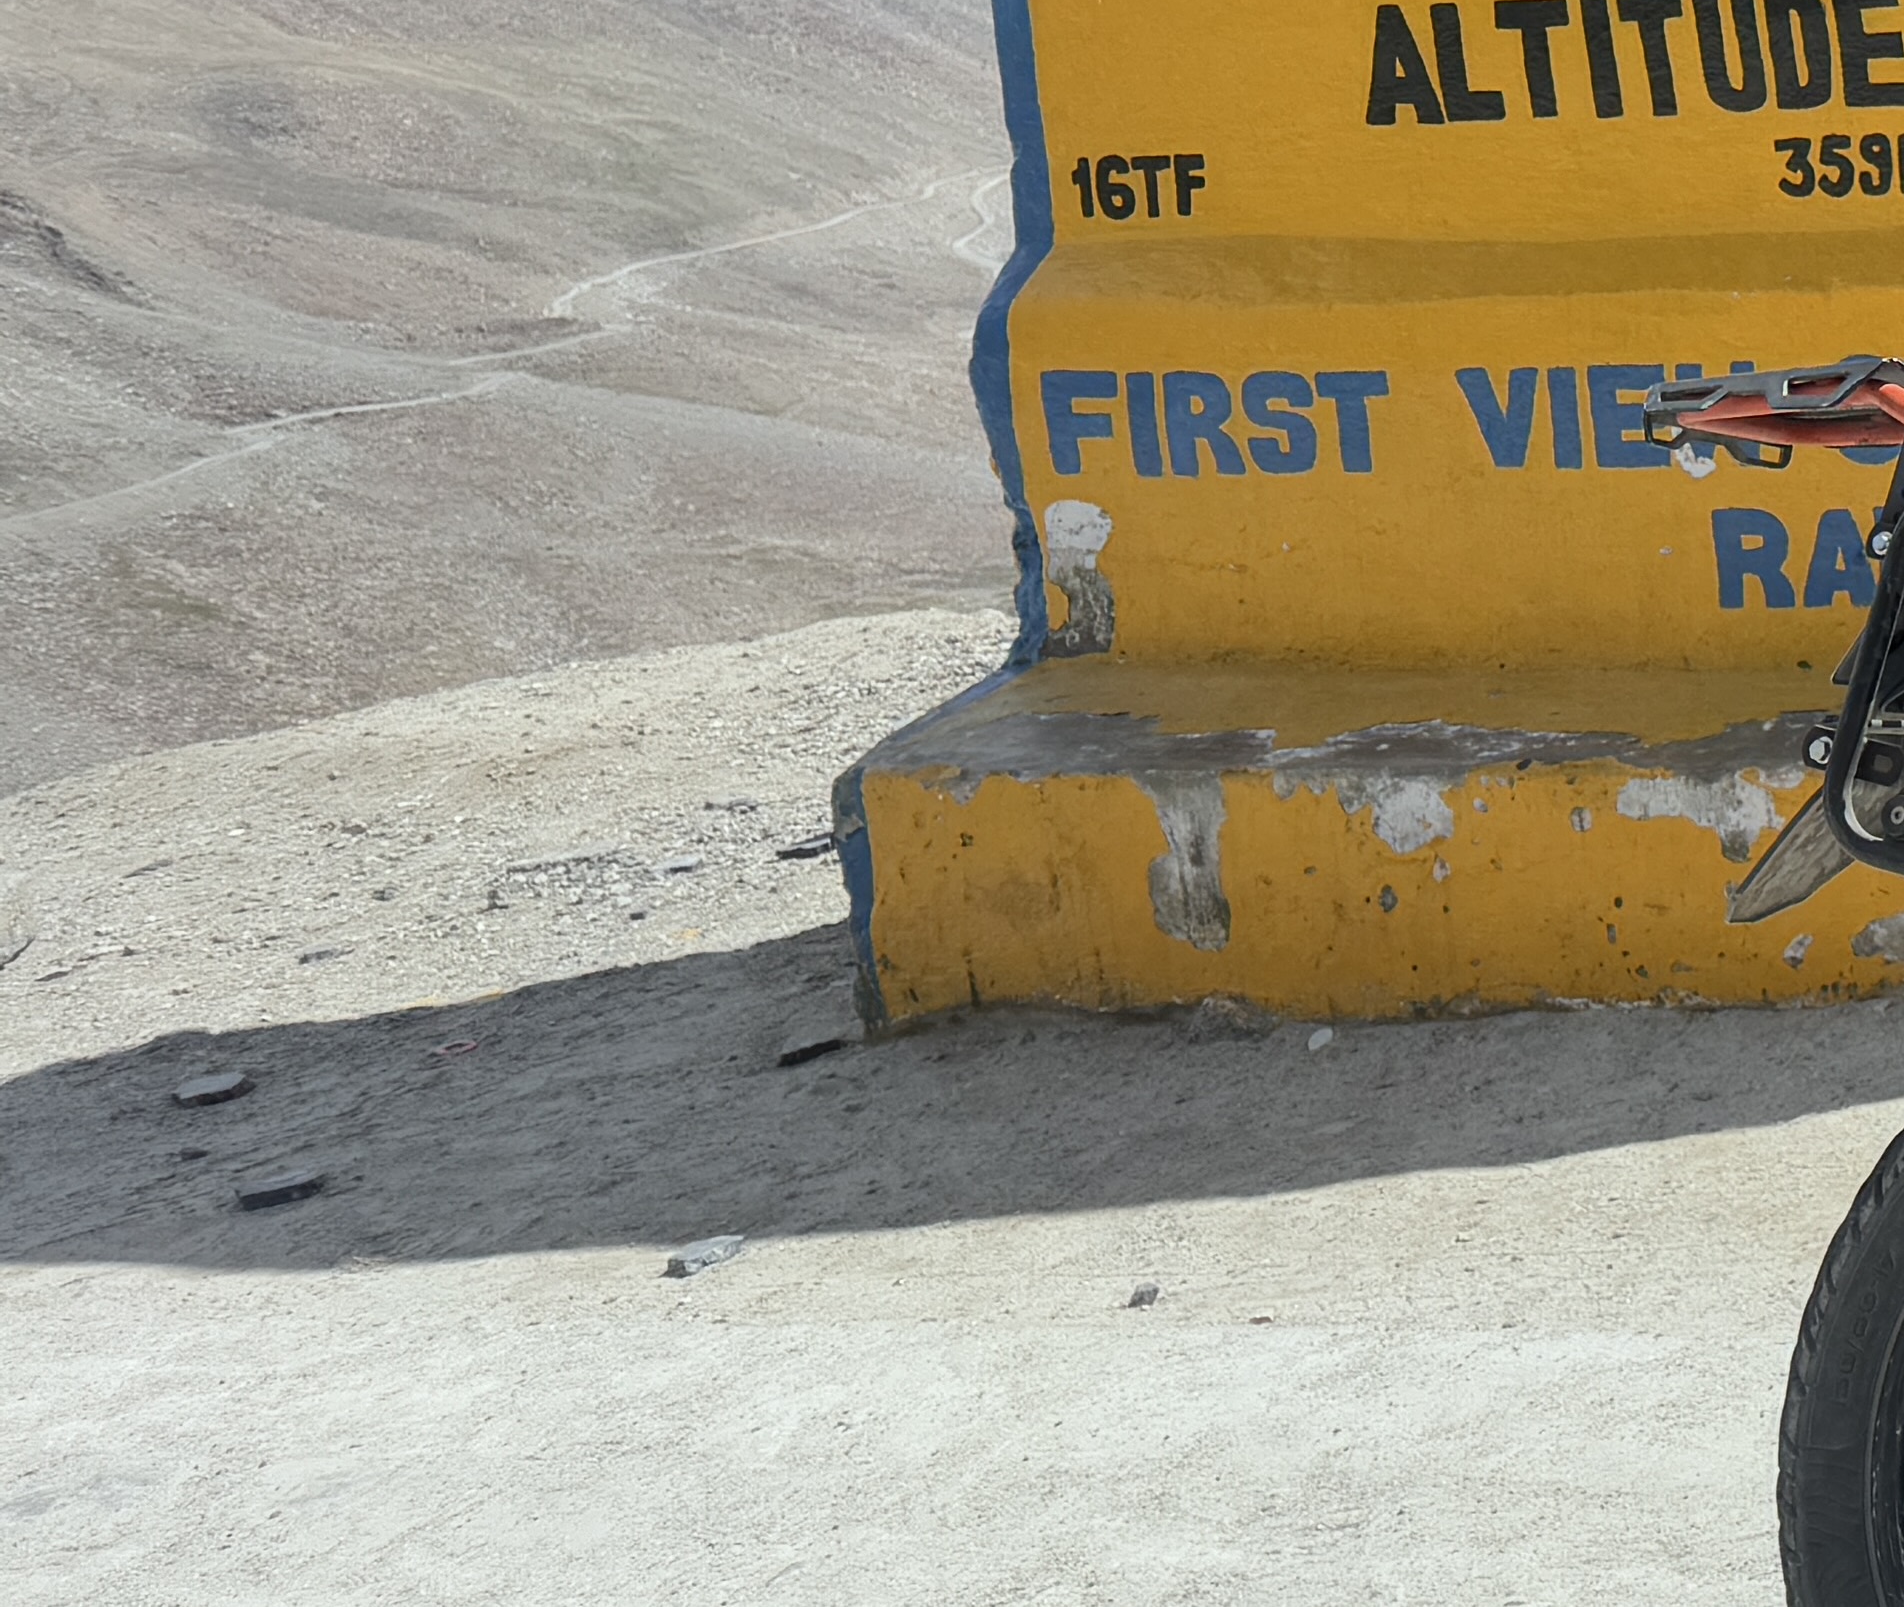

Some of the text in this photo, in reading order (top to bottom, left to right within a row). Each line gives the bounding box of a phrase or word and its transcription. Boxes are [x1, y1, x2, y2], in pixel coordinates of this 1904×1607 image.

[1071, 154, 1206, 220] 16TF
[1040, 370, 1390, 477] FIRST
[1456, 361, 1760, 470] VIE
